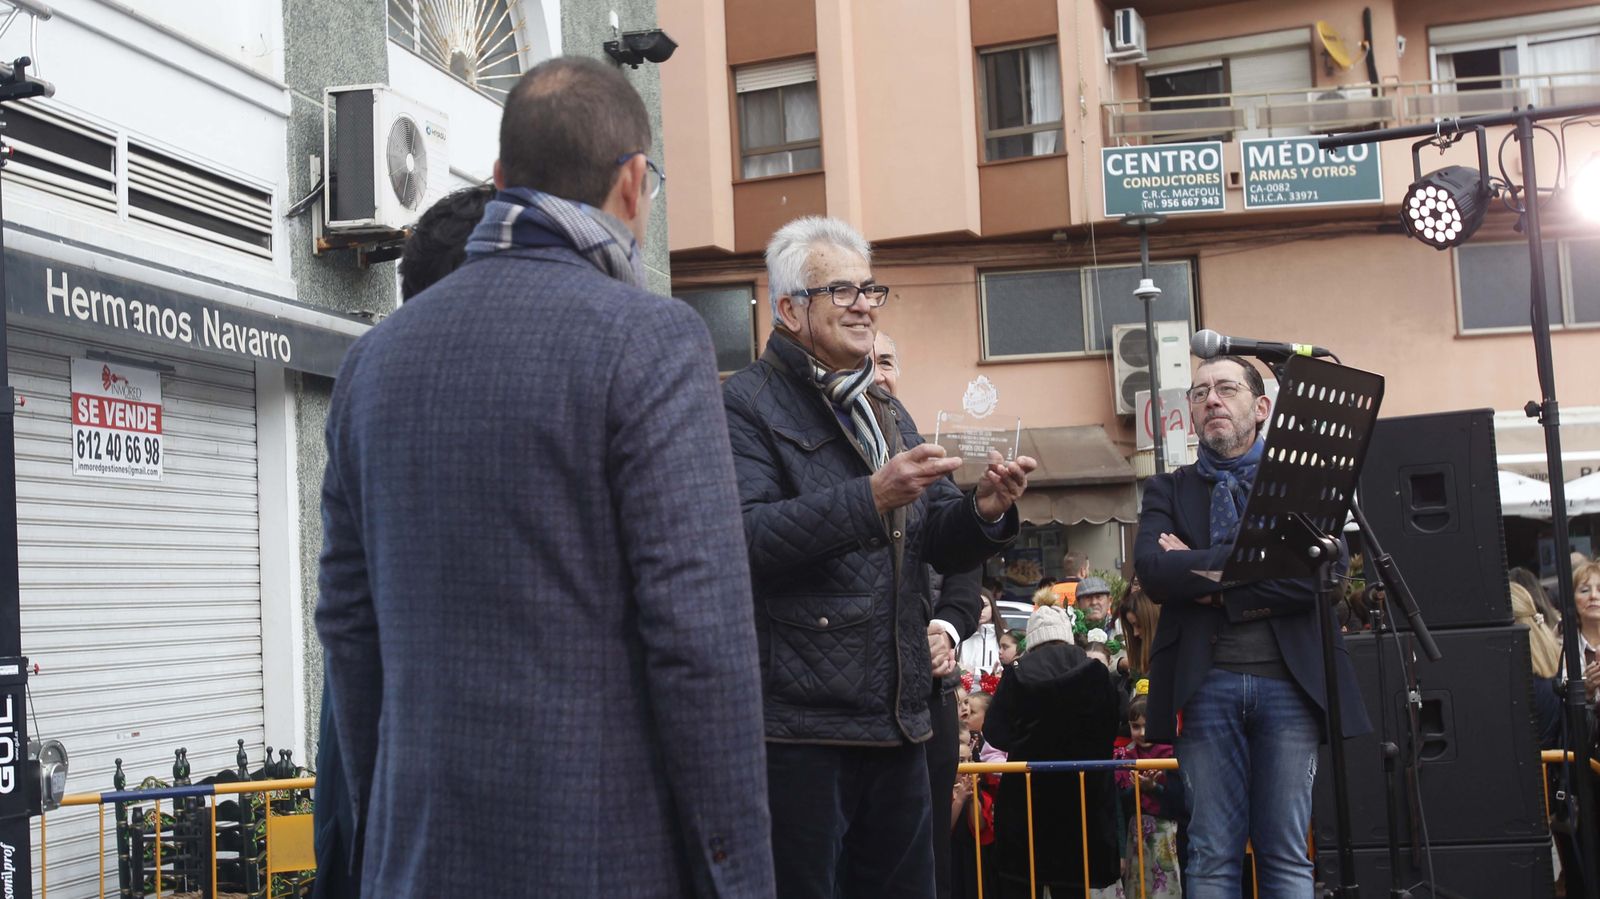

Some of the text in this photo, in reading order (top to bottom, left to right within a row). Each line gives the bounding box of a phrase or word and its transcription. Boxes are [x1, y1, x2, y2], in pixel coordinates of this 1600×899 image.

[1106, 148, 1219, 176] CENTRO
[1123, 173, 1220, 189] CONDUCTORES
[1249, 165, 1357, 182] ARMAS Y OTROS
[1142, 187, 1220, 199] C.R.C. MACFOUL
[1250, 183, 1290, 193] CA-0082
[1143, 196, 1220, 209] Tel. 956 667 943
[1250, 191, 1319, 203] N.I.C.A. 33971
[46, 268, 291, 363] Hermanos Navarro
[78, 397, 157, 432] SE VENDE
[77, 429, 160, 466] 612 40 66 98
